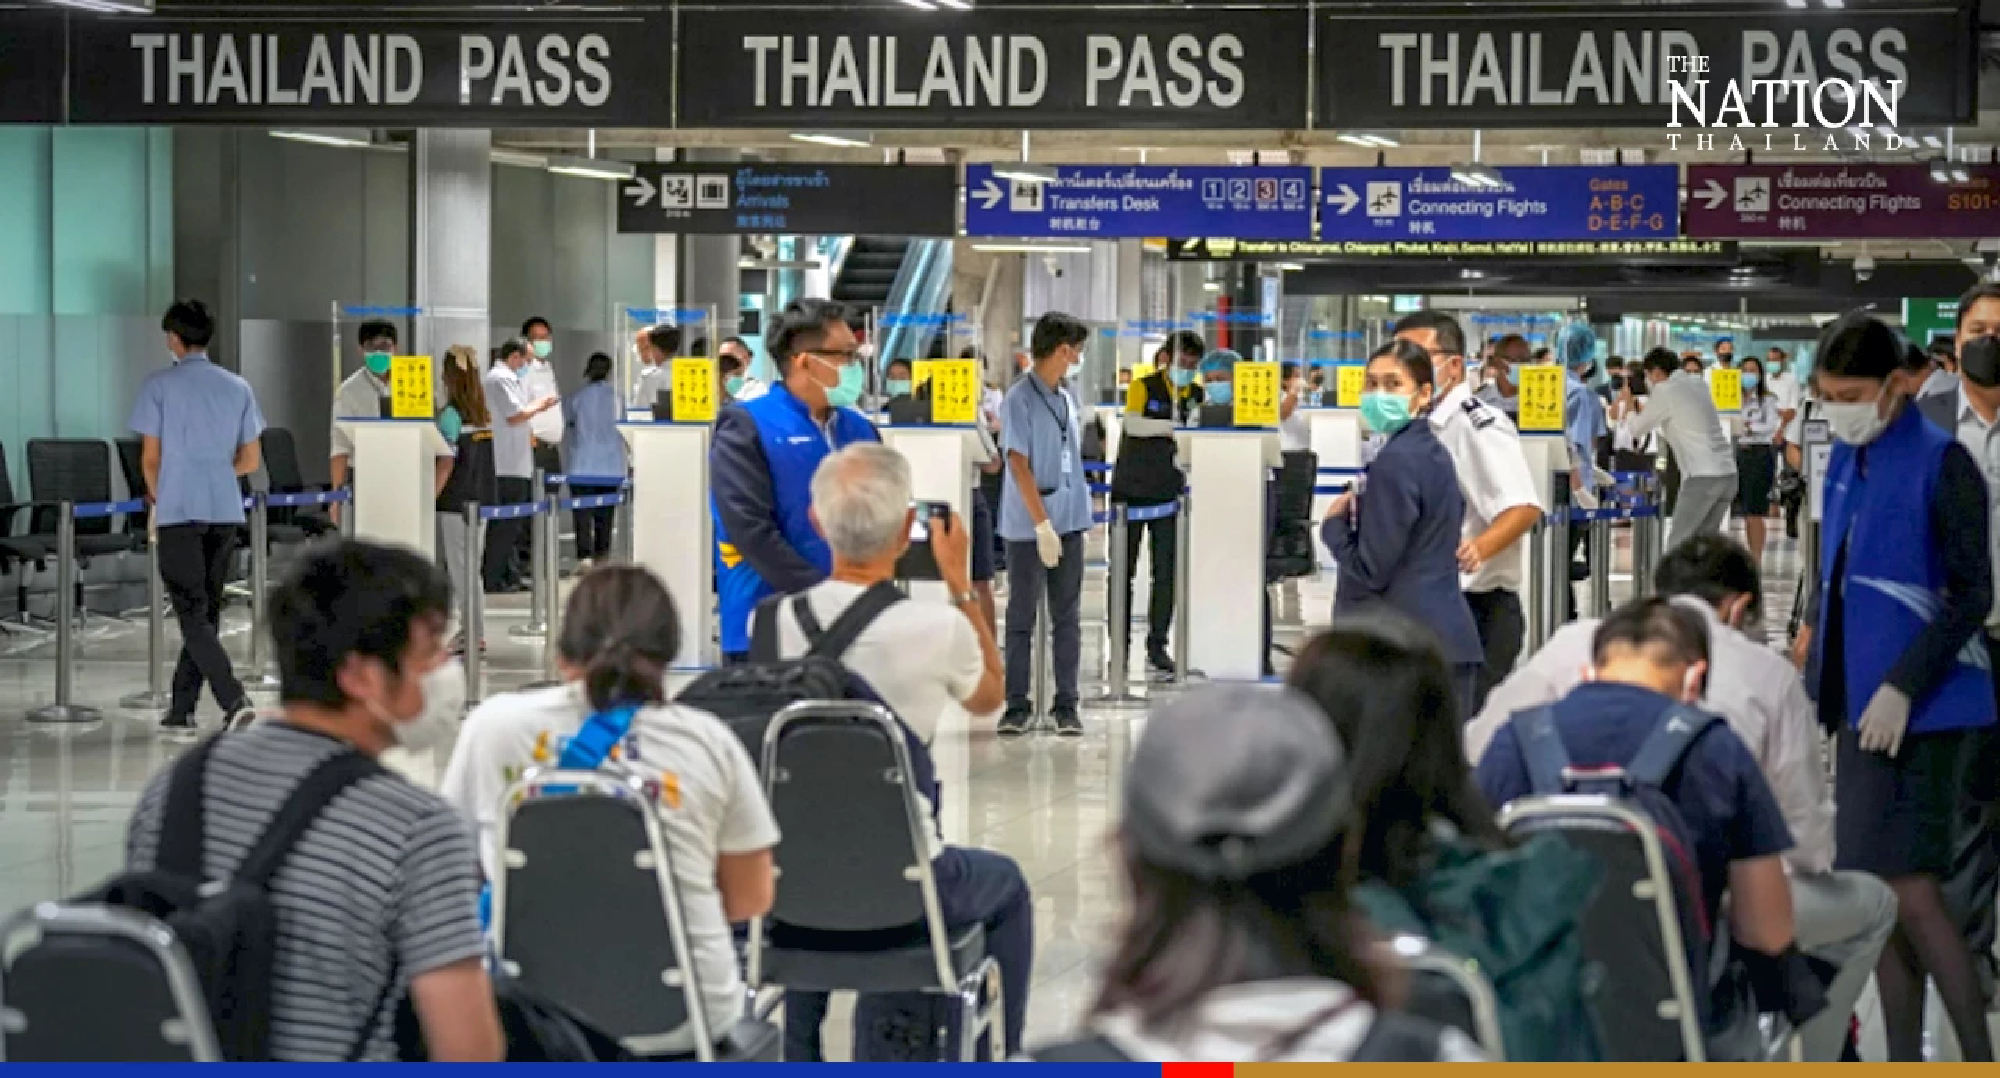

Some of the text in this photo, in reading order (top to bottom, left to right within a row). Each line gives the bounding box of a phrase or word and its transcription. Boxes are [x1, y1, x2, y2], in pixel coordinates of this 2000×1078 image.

[131, 33, 611, 106] THAILAND PASS
[744, 34, 1244, 107] THAILAND PASS
[1379, 28, 1908, 106] THAILAND PASS
[1209, 181, 1298, 198] 1 2 3 4
[736, 195, 790, 209] Arrivals
[1050, 194, 1160, 211] Transfers Desk
[1408, 199, 1548, 218] Connecting Flights
[1778, 194, 1921, 213] Connecting Flights
